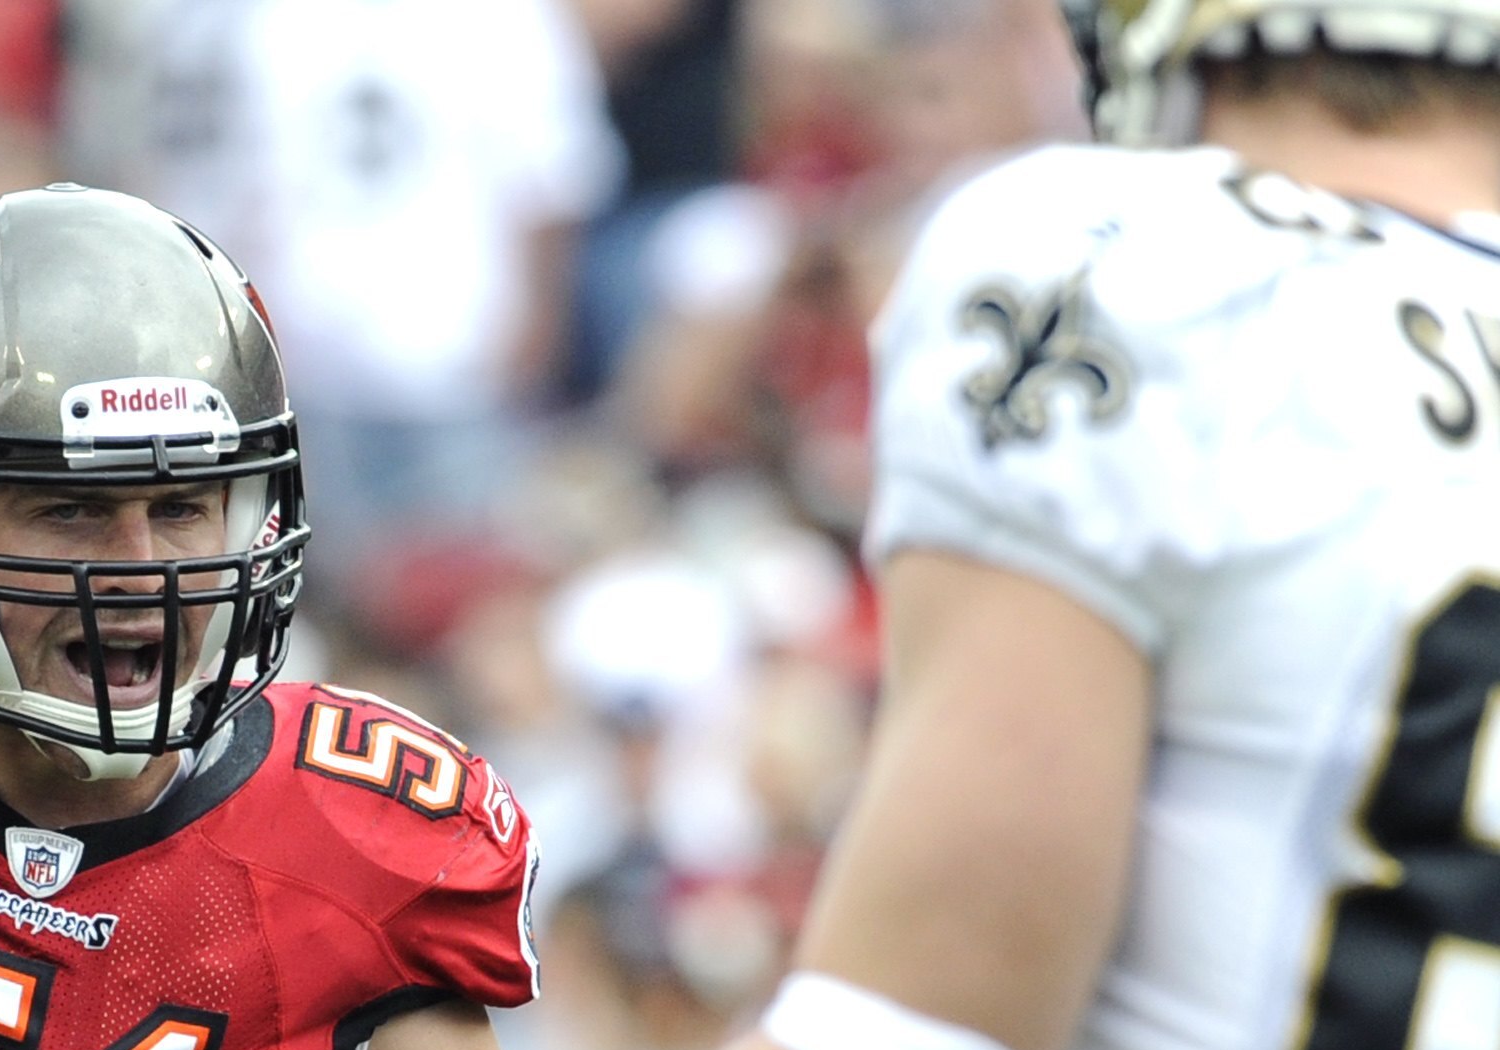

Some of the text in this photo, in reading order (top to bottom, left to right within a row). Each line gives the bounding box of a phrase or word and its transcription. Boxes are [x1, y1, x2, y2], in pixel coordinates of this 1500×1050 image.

[1396, 298, 1500, 452] S
[101, 387, 188, 413] Riddell
[25, 860, 55, 884] NFL
